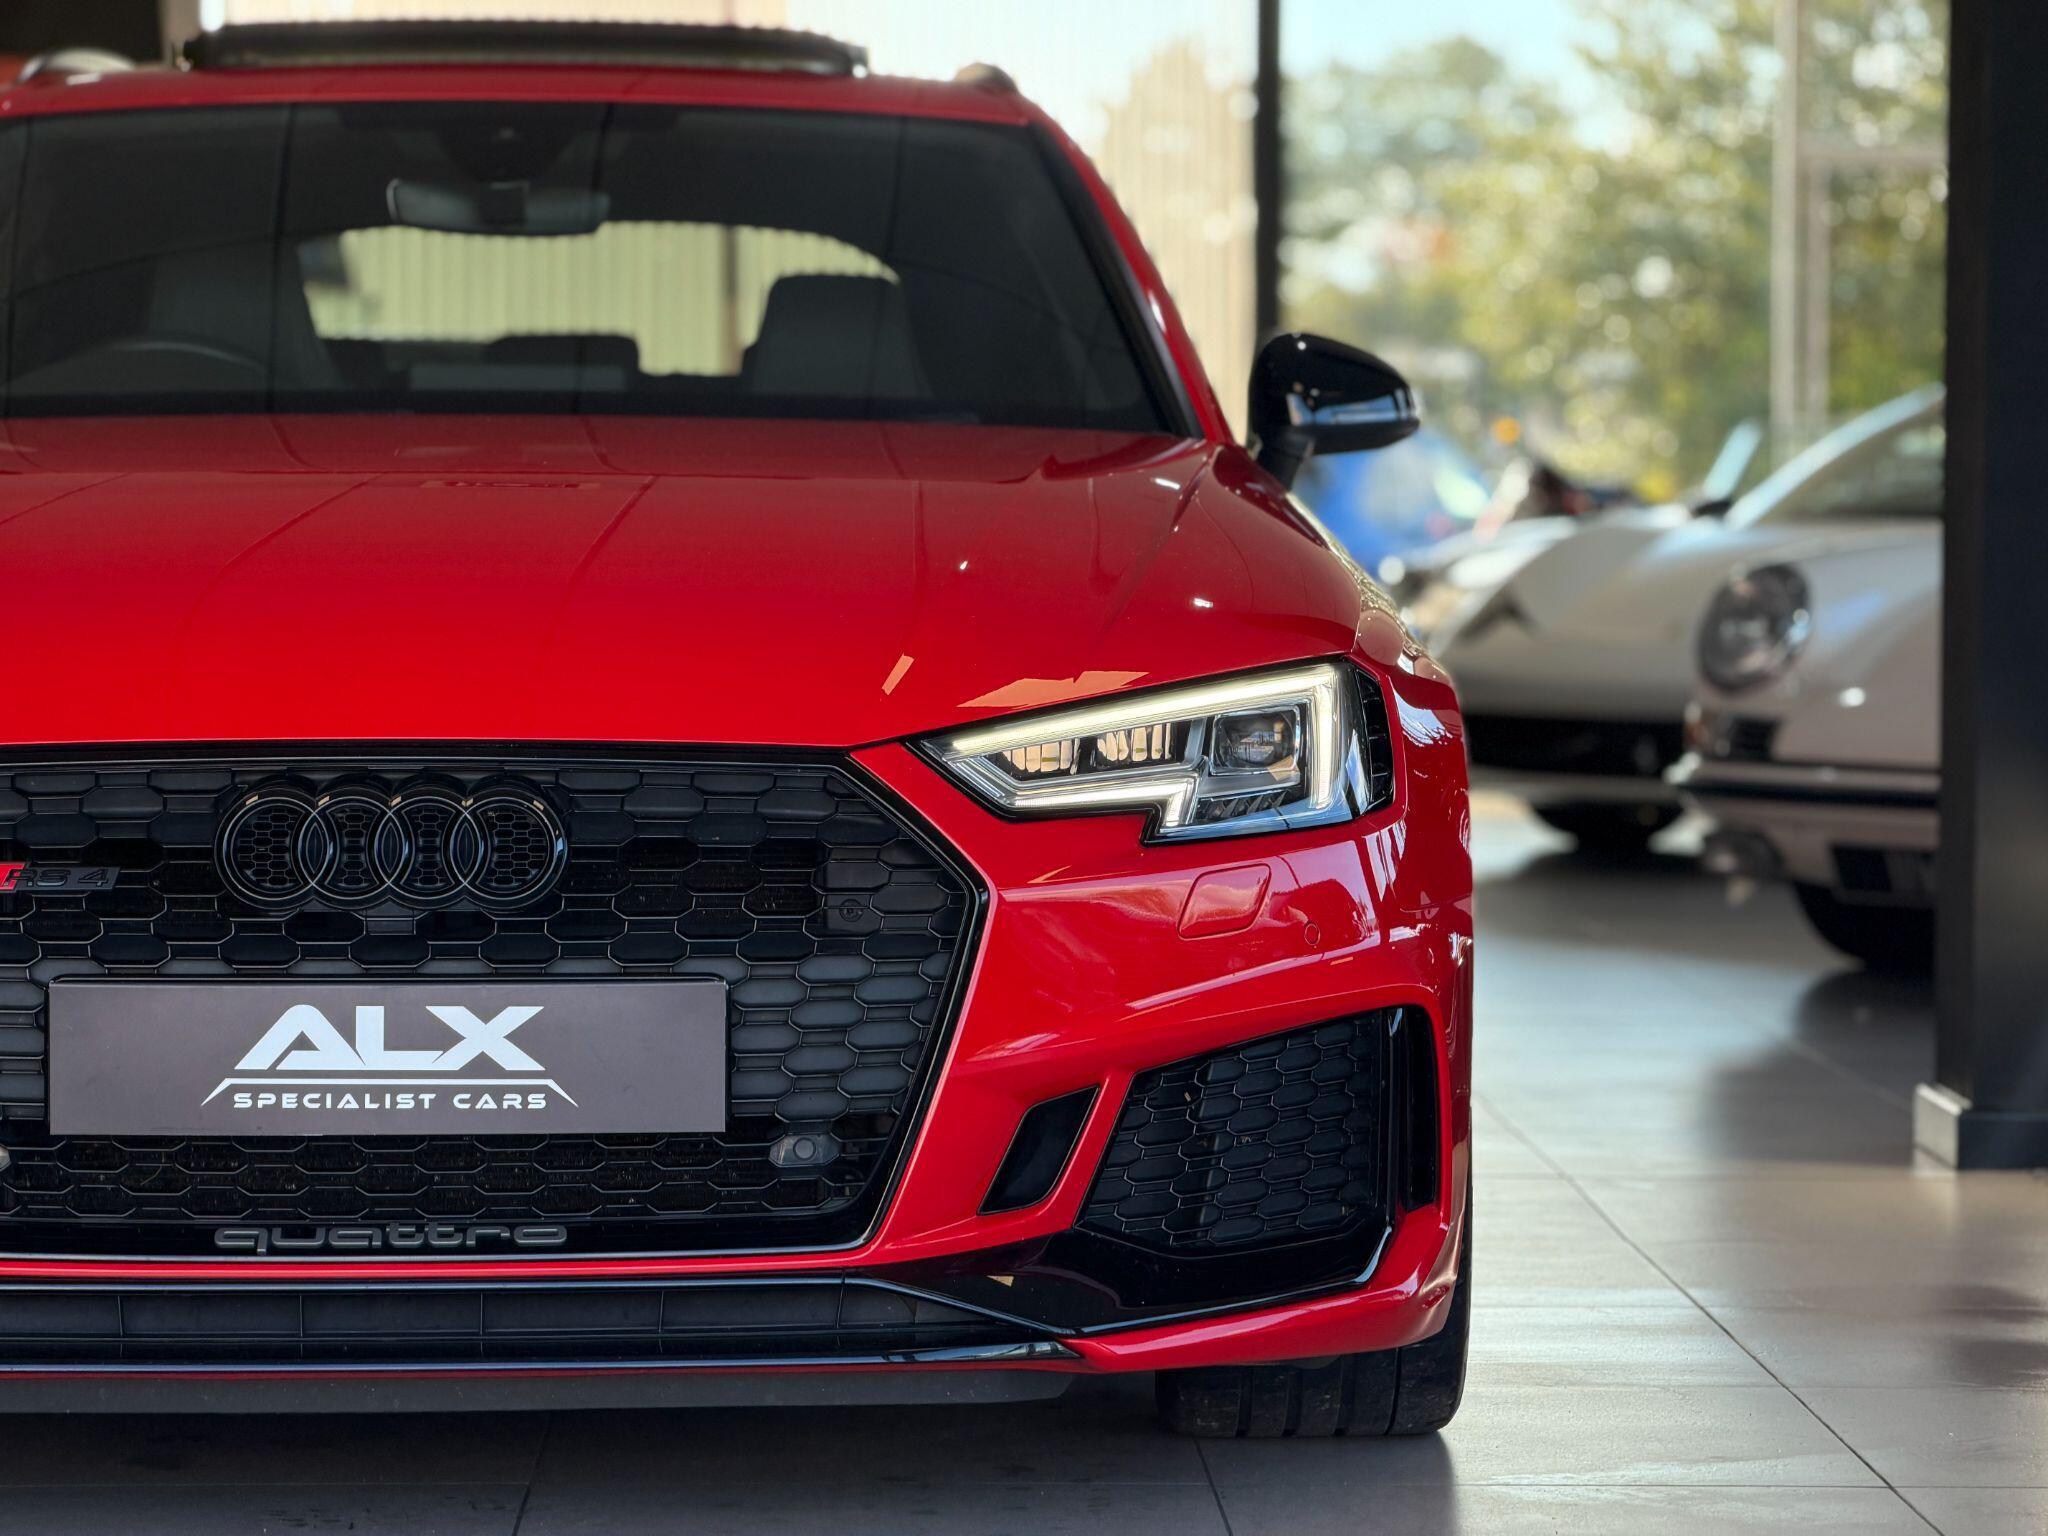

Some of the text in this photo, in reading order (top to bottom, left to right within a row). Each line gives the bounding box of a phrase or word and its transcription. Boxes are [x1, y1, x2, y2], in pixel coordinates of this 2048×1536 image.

[3, 868, 109, 887] RS 4
[234, 1004, 546, 1071] ALX
[234, 1093, 547, 1110] SPECIALIST CARS
[214, 1223, 568, 1255] quattro
